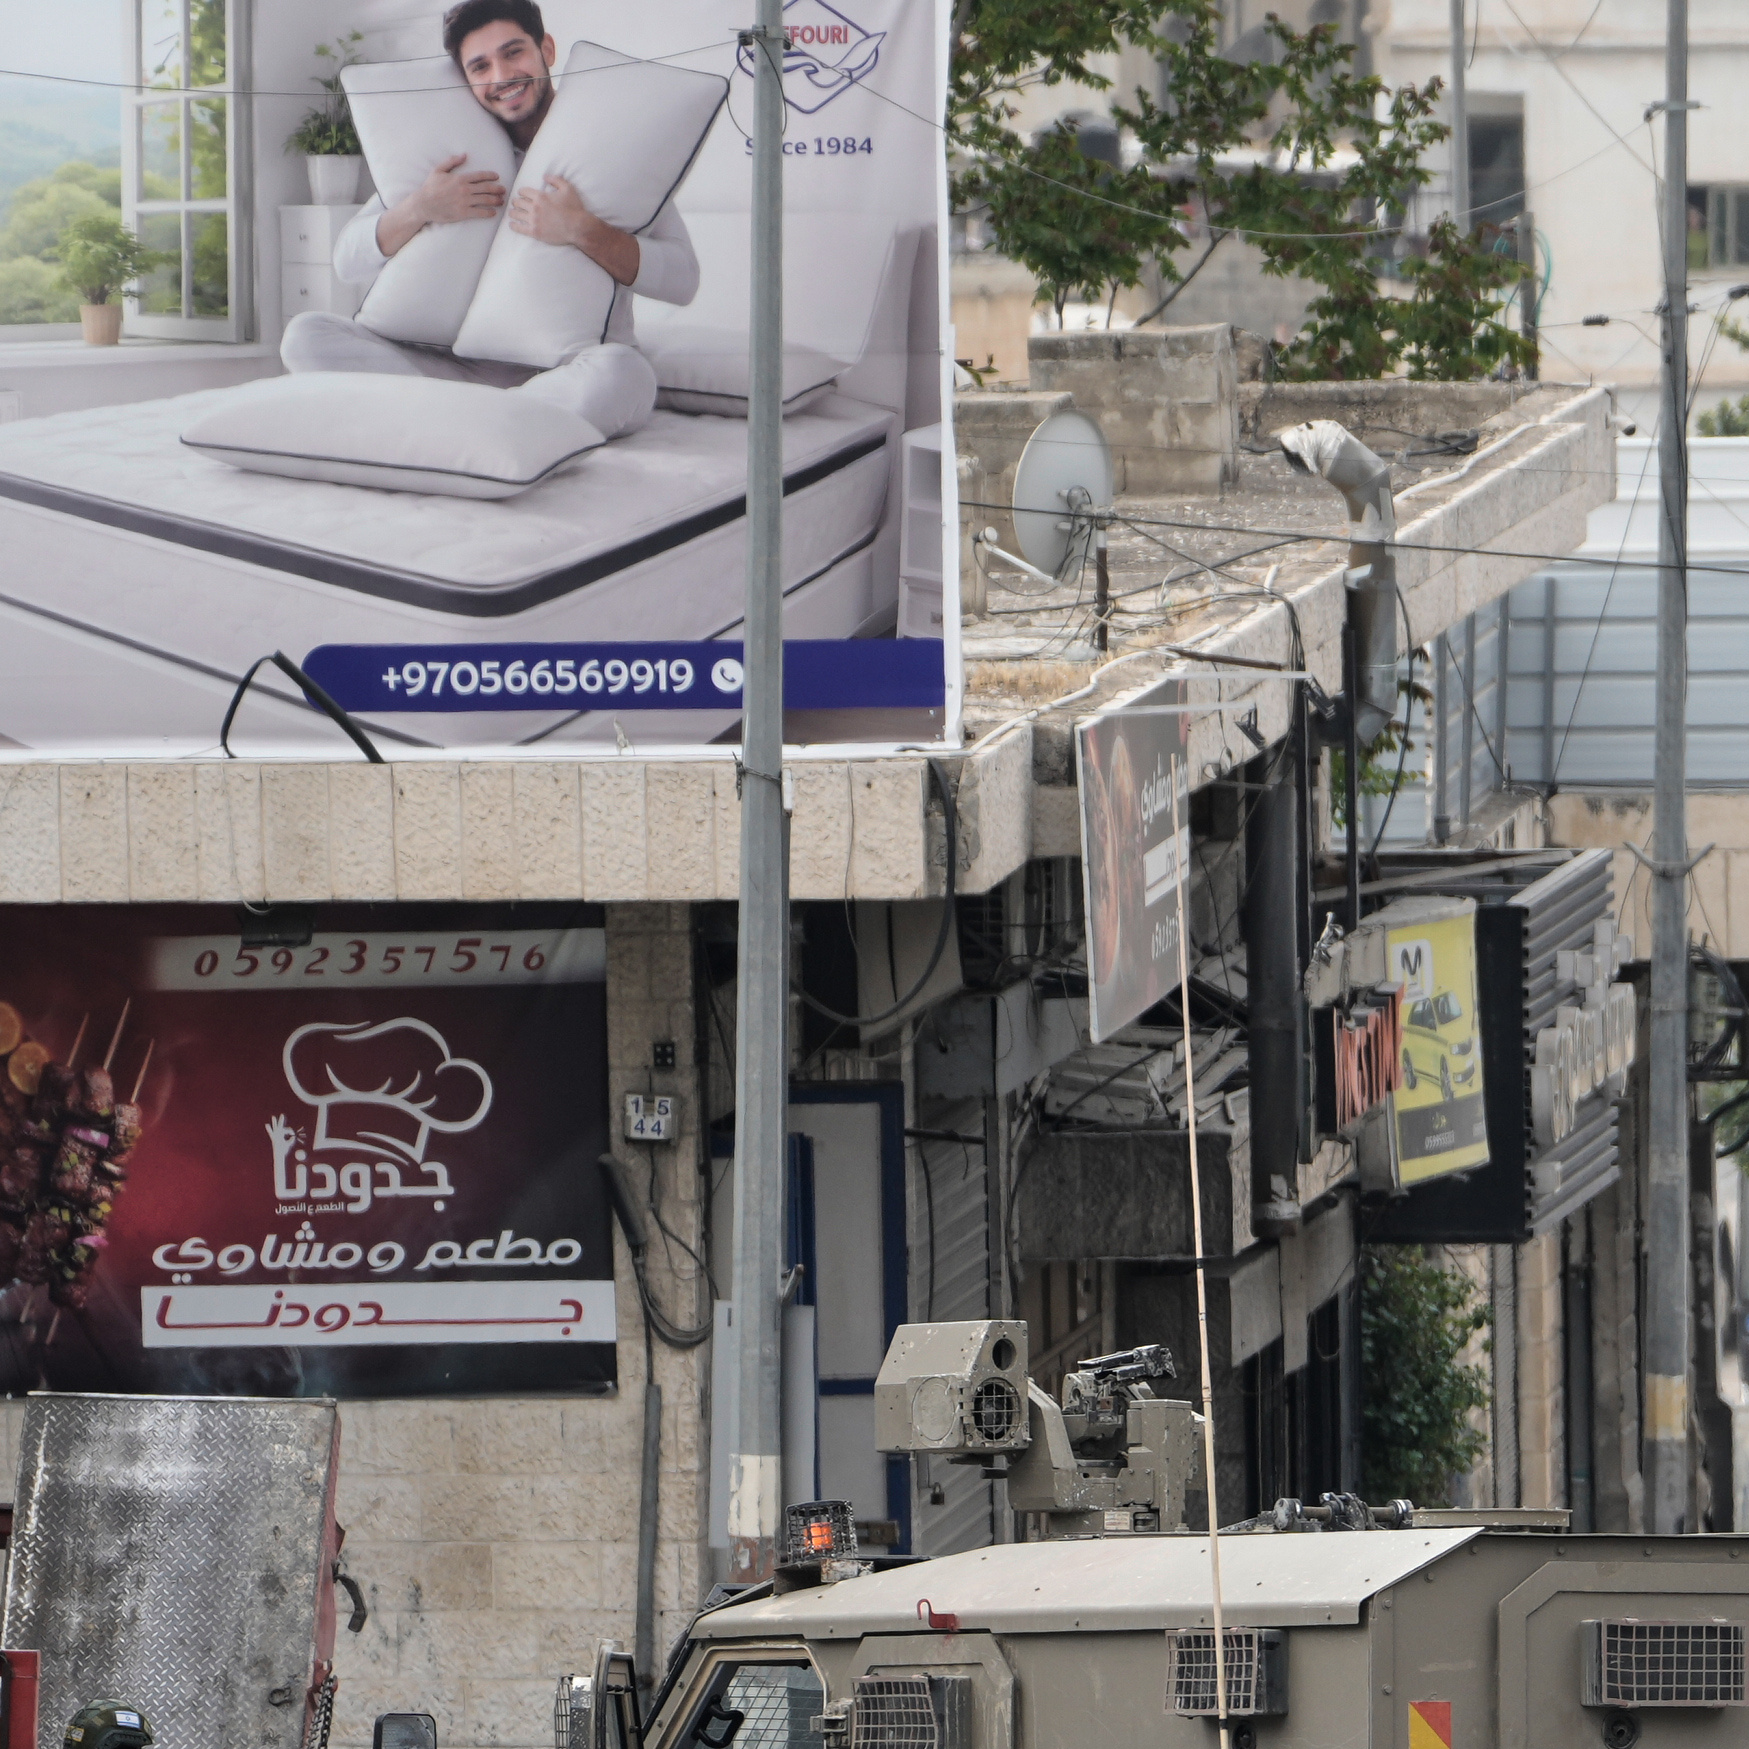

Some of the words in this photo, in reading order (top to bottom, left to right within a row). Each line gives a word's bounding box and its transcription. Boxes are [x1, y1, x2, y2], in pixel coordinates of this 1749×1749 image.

[814, 136, 873, 155] 1984
[381, 658, 694, 695] +970566569919
[193, 936, 547, 979] 0592357576
[414, 1230, 582, 1271] مطعم
[155, 1290, 583, 1336] جدودنا
